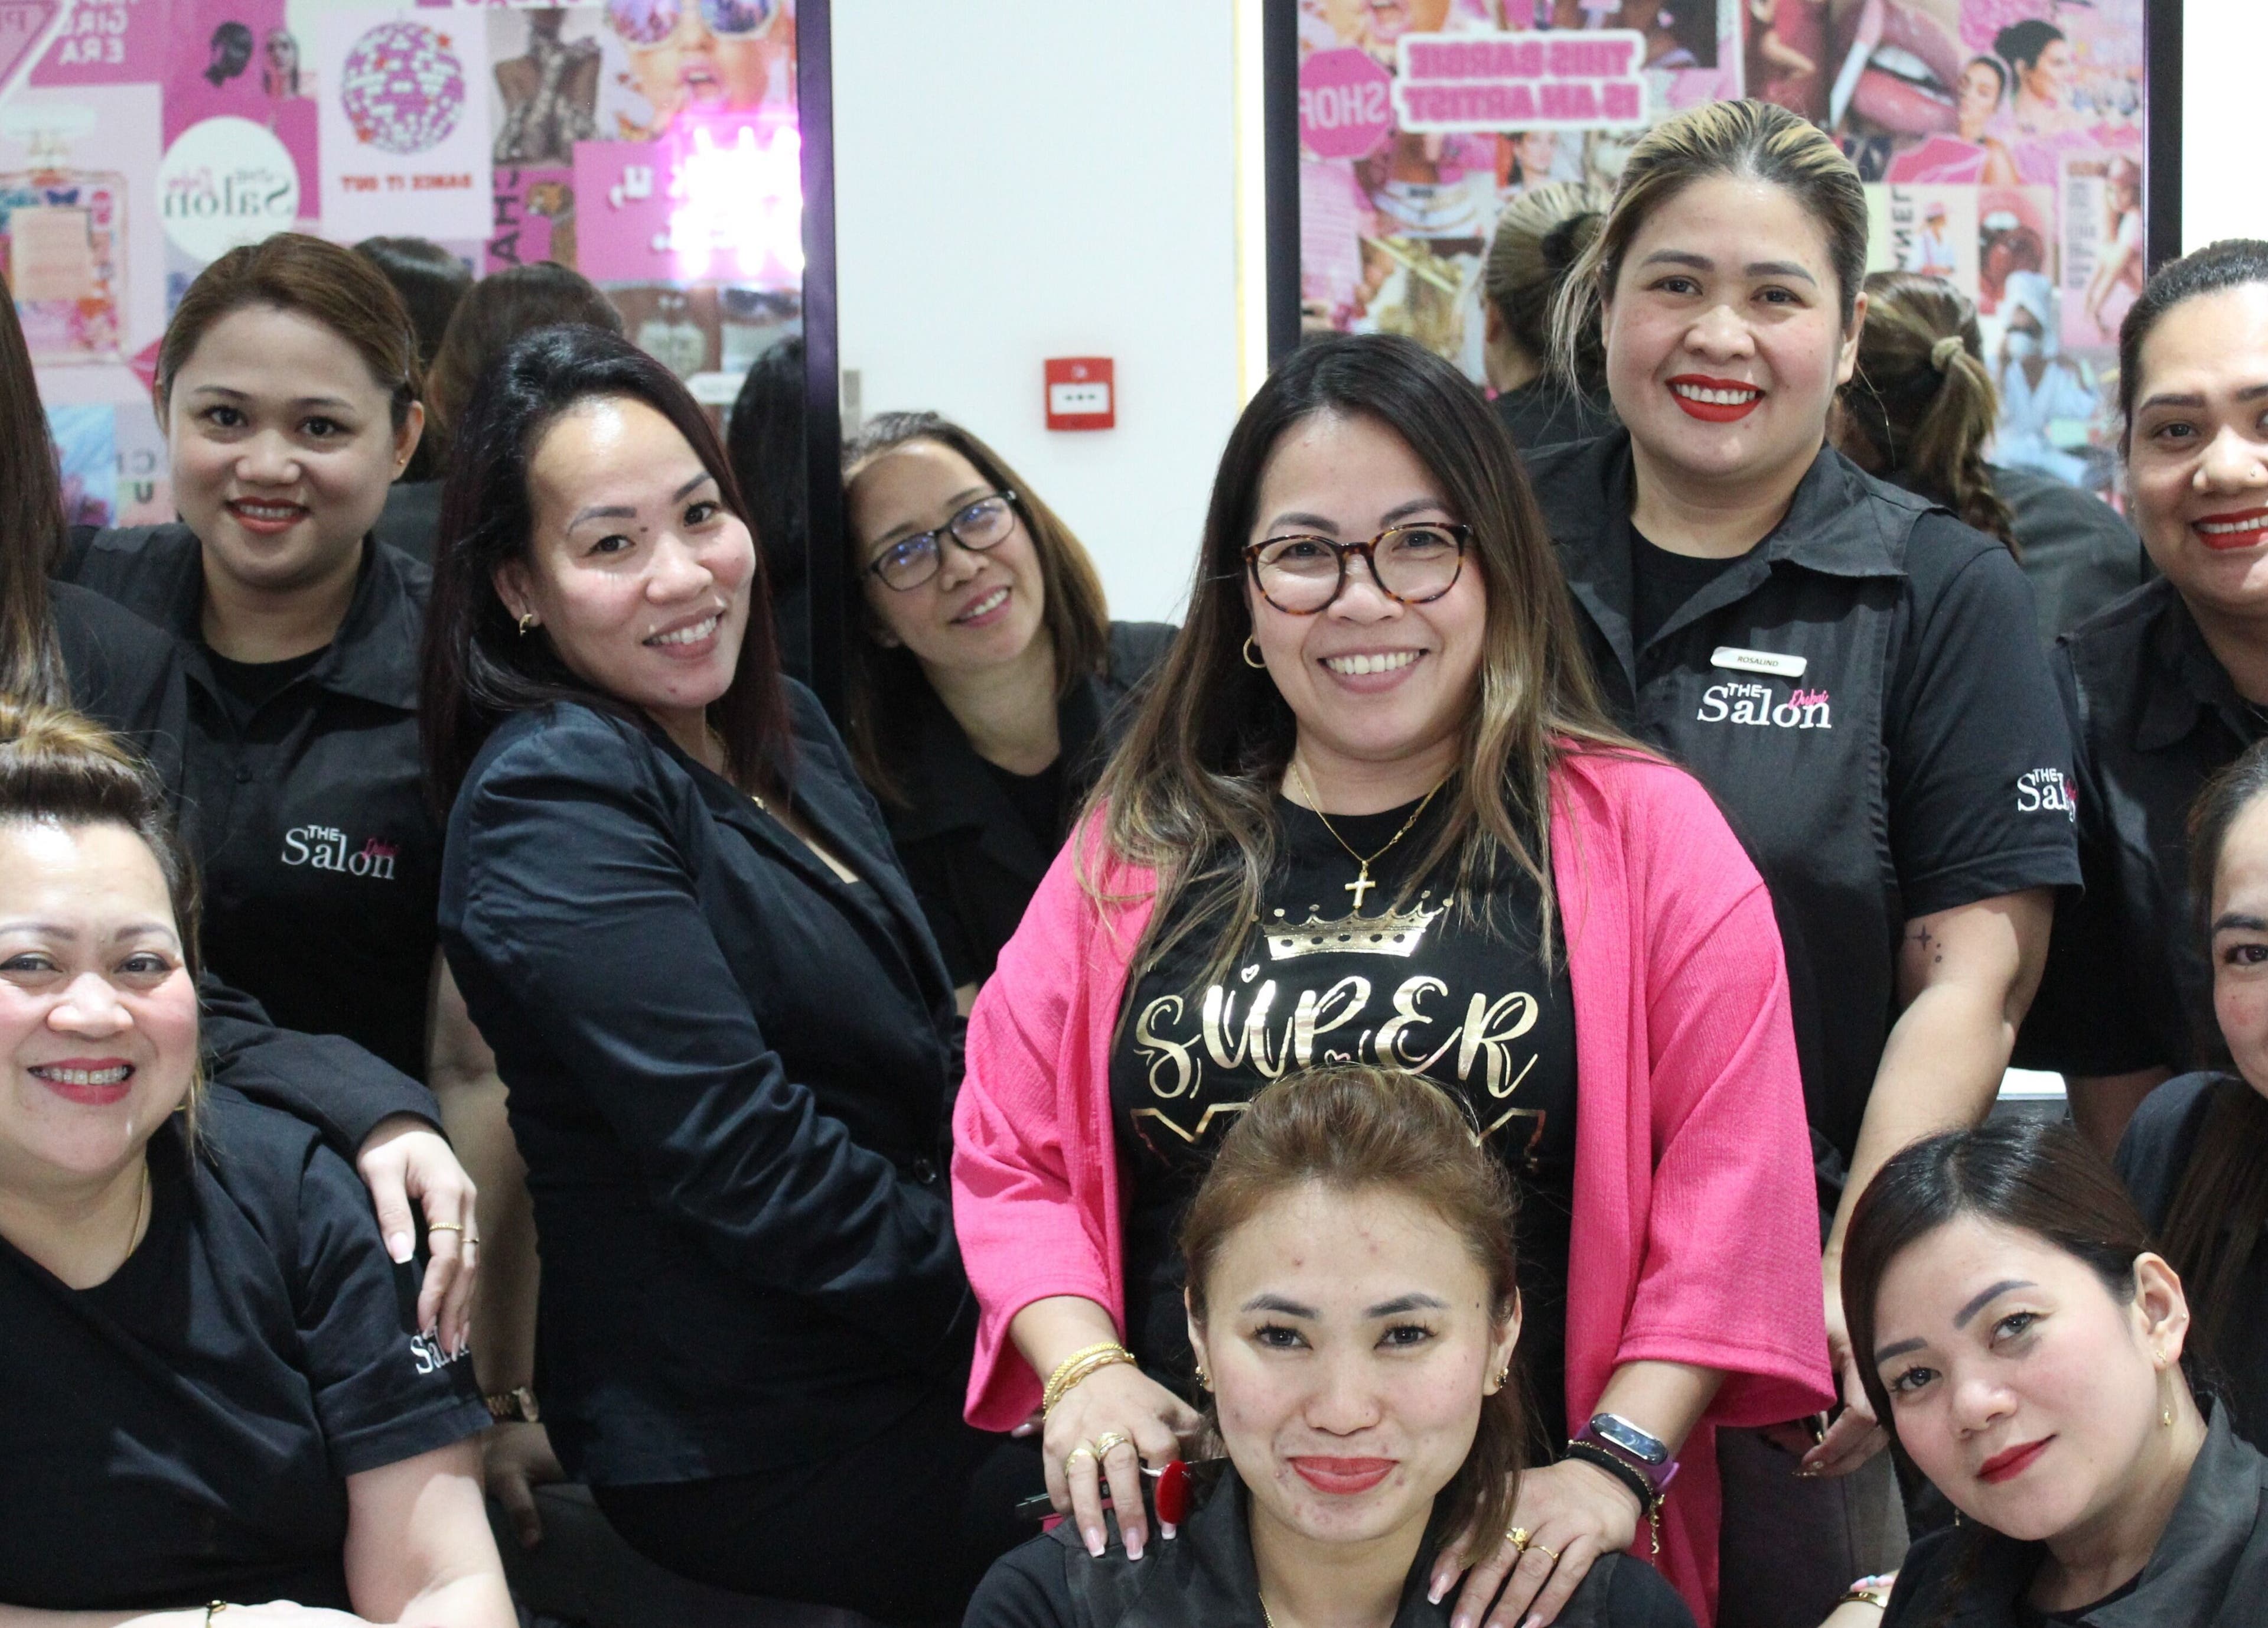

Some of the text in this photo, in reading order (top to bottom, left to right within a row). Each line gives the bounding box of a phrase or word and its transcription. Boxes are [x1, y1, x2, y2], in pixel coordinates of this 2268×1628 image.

[1736, 656, 1779, 668] ROSALIND
[1728, 682, 1762, 698] THE
[1697, 685, 1832, 728] Salon
[2032, 767, 2058, 783] THE
[308, 825, 340, 841] THE
[281, 828, 395, 880] Salon
